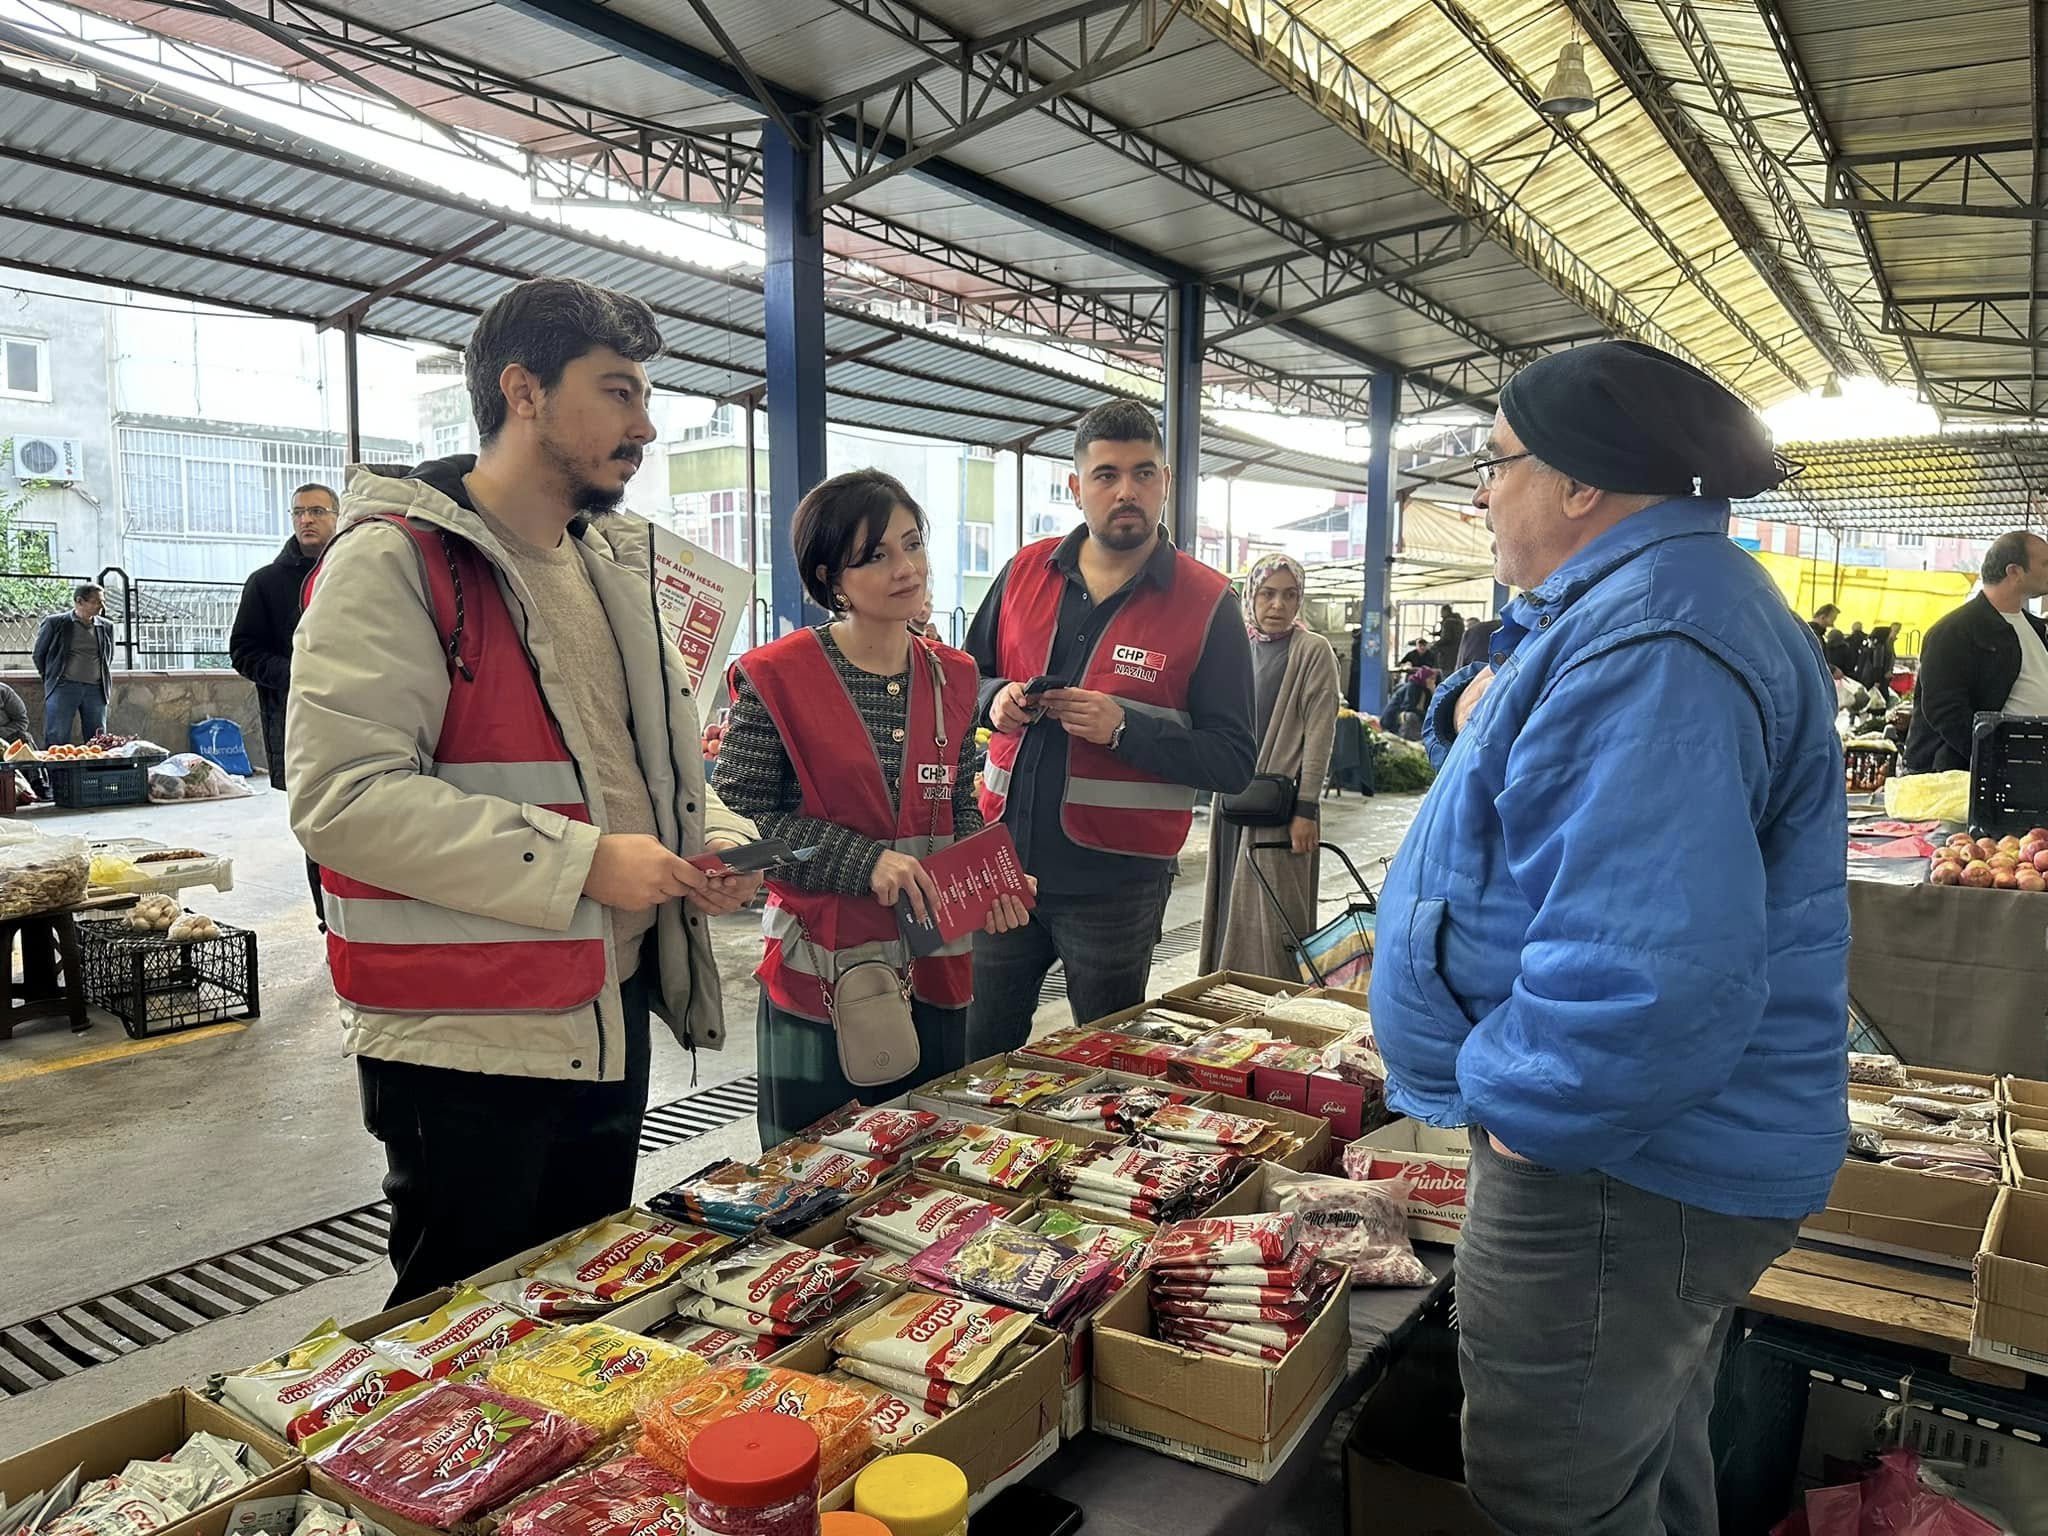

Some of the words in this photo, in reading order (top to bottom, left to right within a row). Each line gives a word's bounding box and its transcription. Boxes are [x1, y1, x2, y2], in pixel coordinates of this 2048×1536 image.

[672, 562, 696, 579] ALTIN
[696, 574, 725, 593] HESABI
[660, 598, 673, 610] 7,5
[698, 609, 706, 618] 7
[681, 640, 698, 653] 5,5
[1116, 648, 1144, 661] CHP
[1114, 663, 1156, 683] NAZİLLİ
[921, 767, 946, 780] CHP
[1394, 1161, 1467, 1191] Günba
[1448, 1208, 1467, 1220] İÇEC
[609, 1231, 649, 1266] muzlu
[580, 1261, 606, 1283] süt
[751, 1265, 791, 1300] kakao
[794, 1261, 834, 1304] Günbak
[912, 1299, 962, 1340] salep
[451, 1324, 509, 1371] Günbak
[279, 1349, 375, 1404] nanelimon
[596, 1345, 650, 1384] Günbak
[323, 1370, 386, 1425] Günbak
[432, 1416, 499, 1479] Günbak
[630, 1506, 686, 1536] Günba
